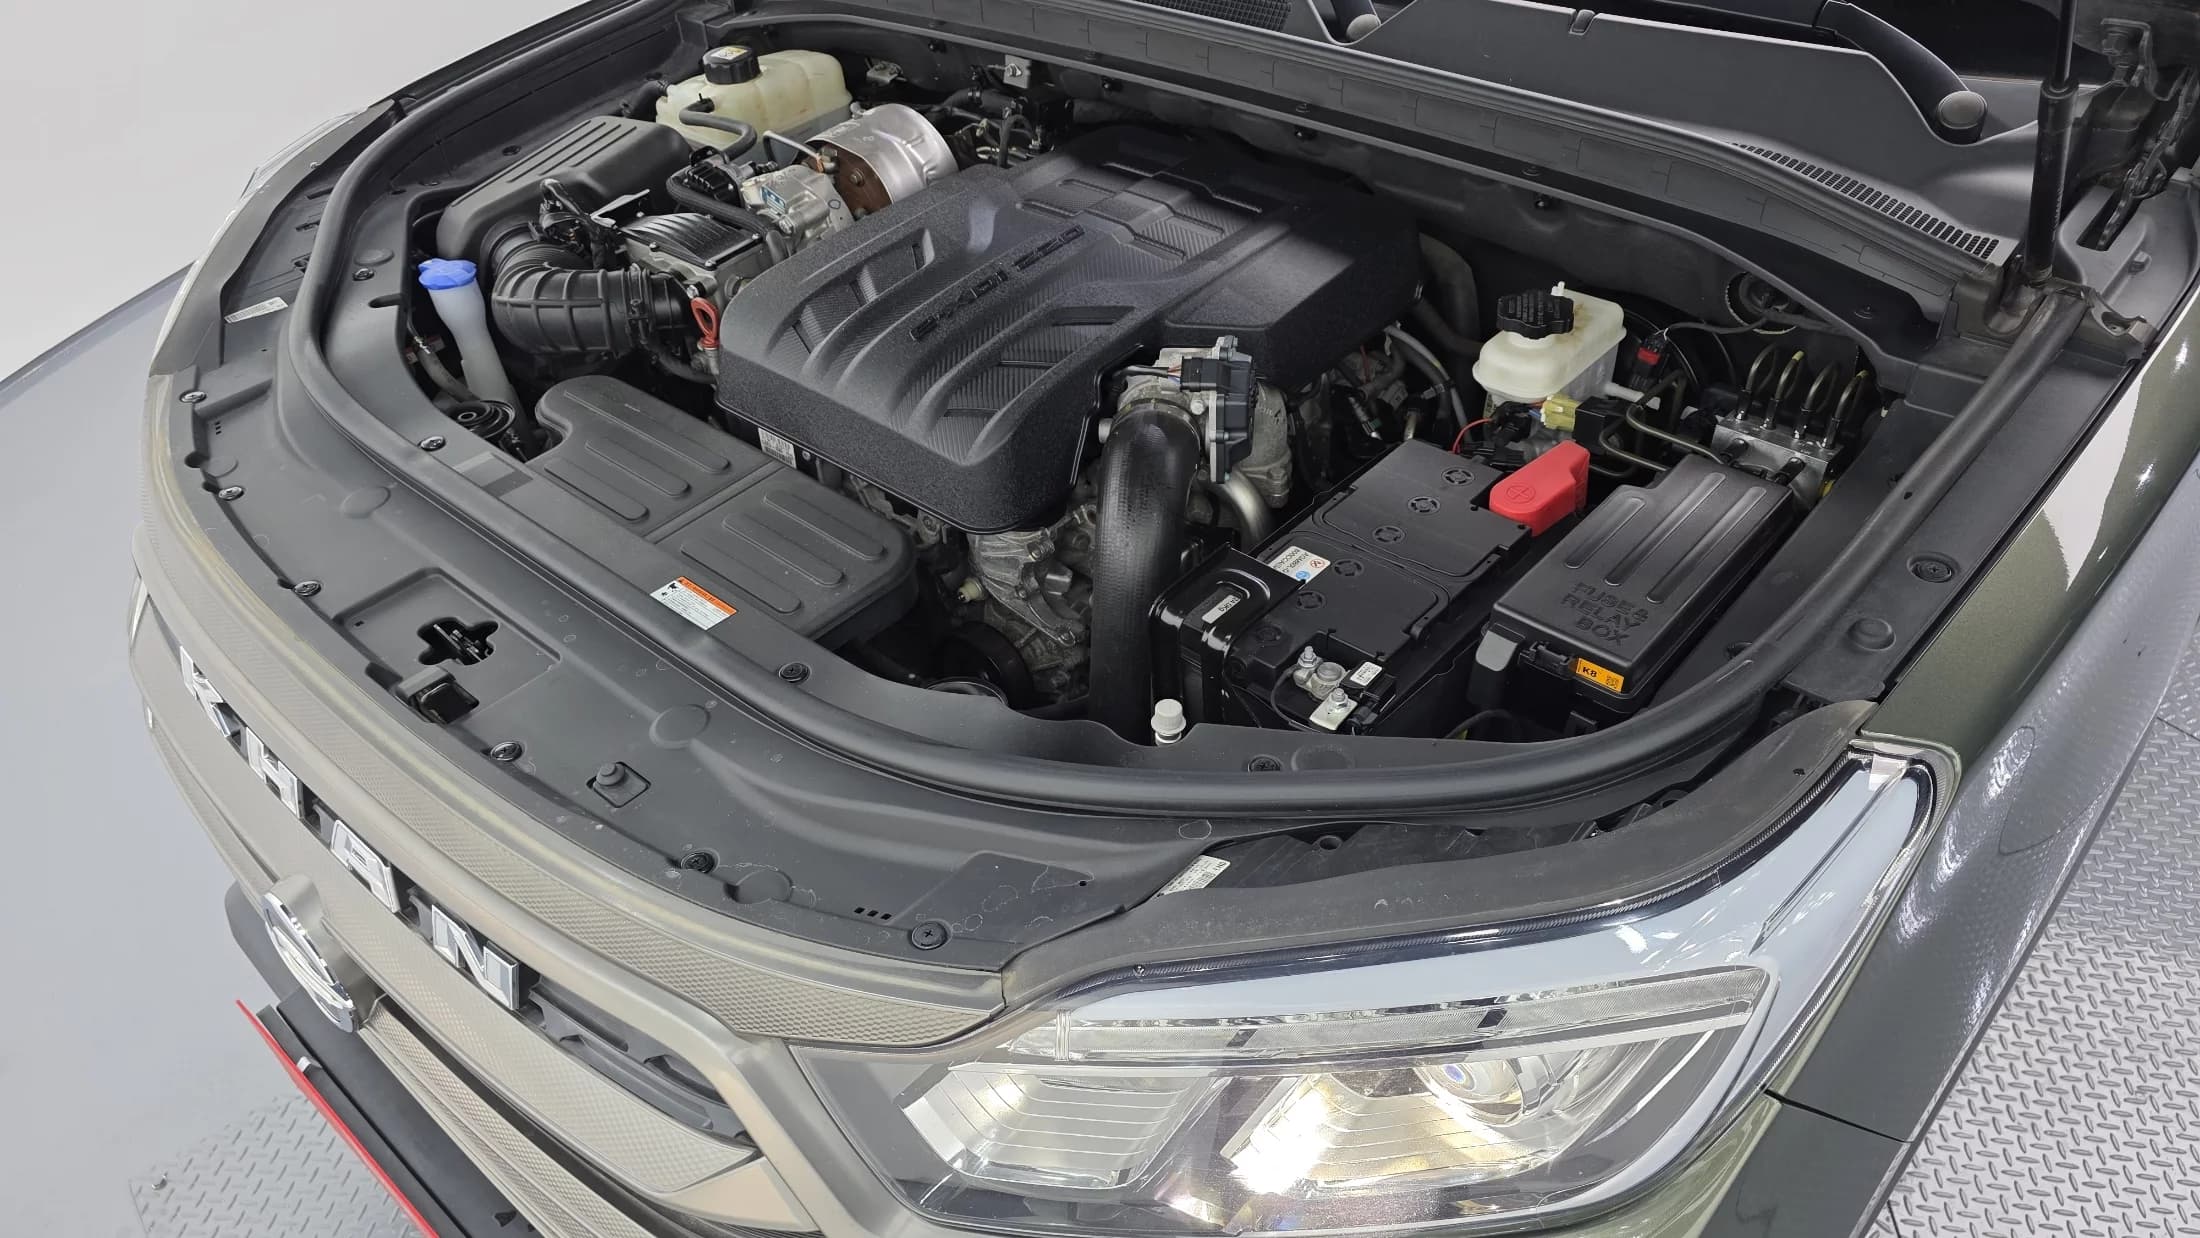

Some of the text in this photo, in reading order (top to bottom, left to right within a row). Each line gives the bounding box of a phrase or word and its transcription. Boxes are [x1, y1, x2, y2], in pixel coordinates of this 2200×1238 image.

[1560, 592, 1642, 634] RELAY
[1576, 616, 1631, 648] BOX
[1582, 666, 1598, 678] K8
[180, 645, 522, 1011] KHAN
